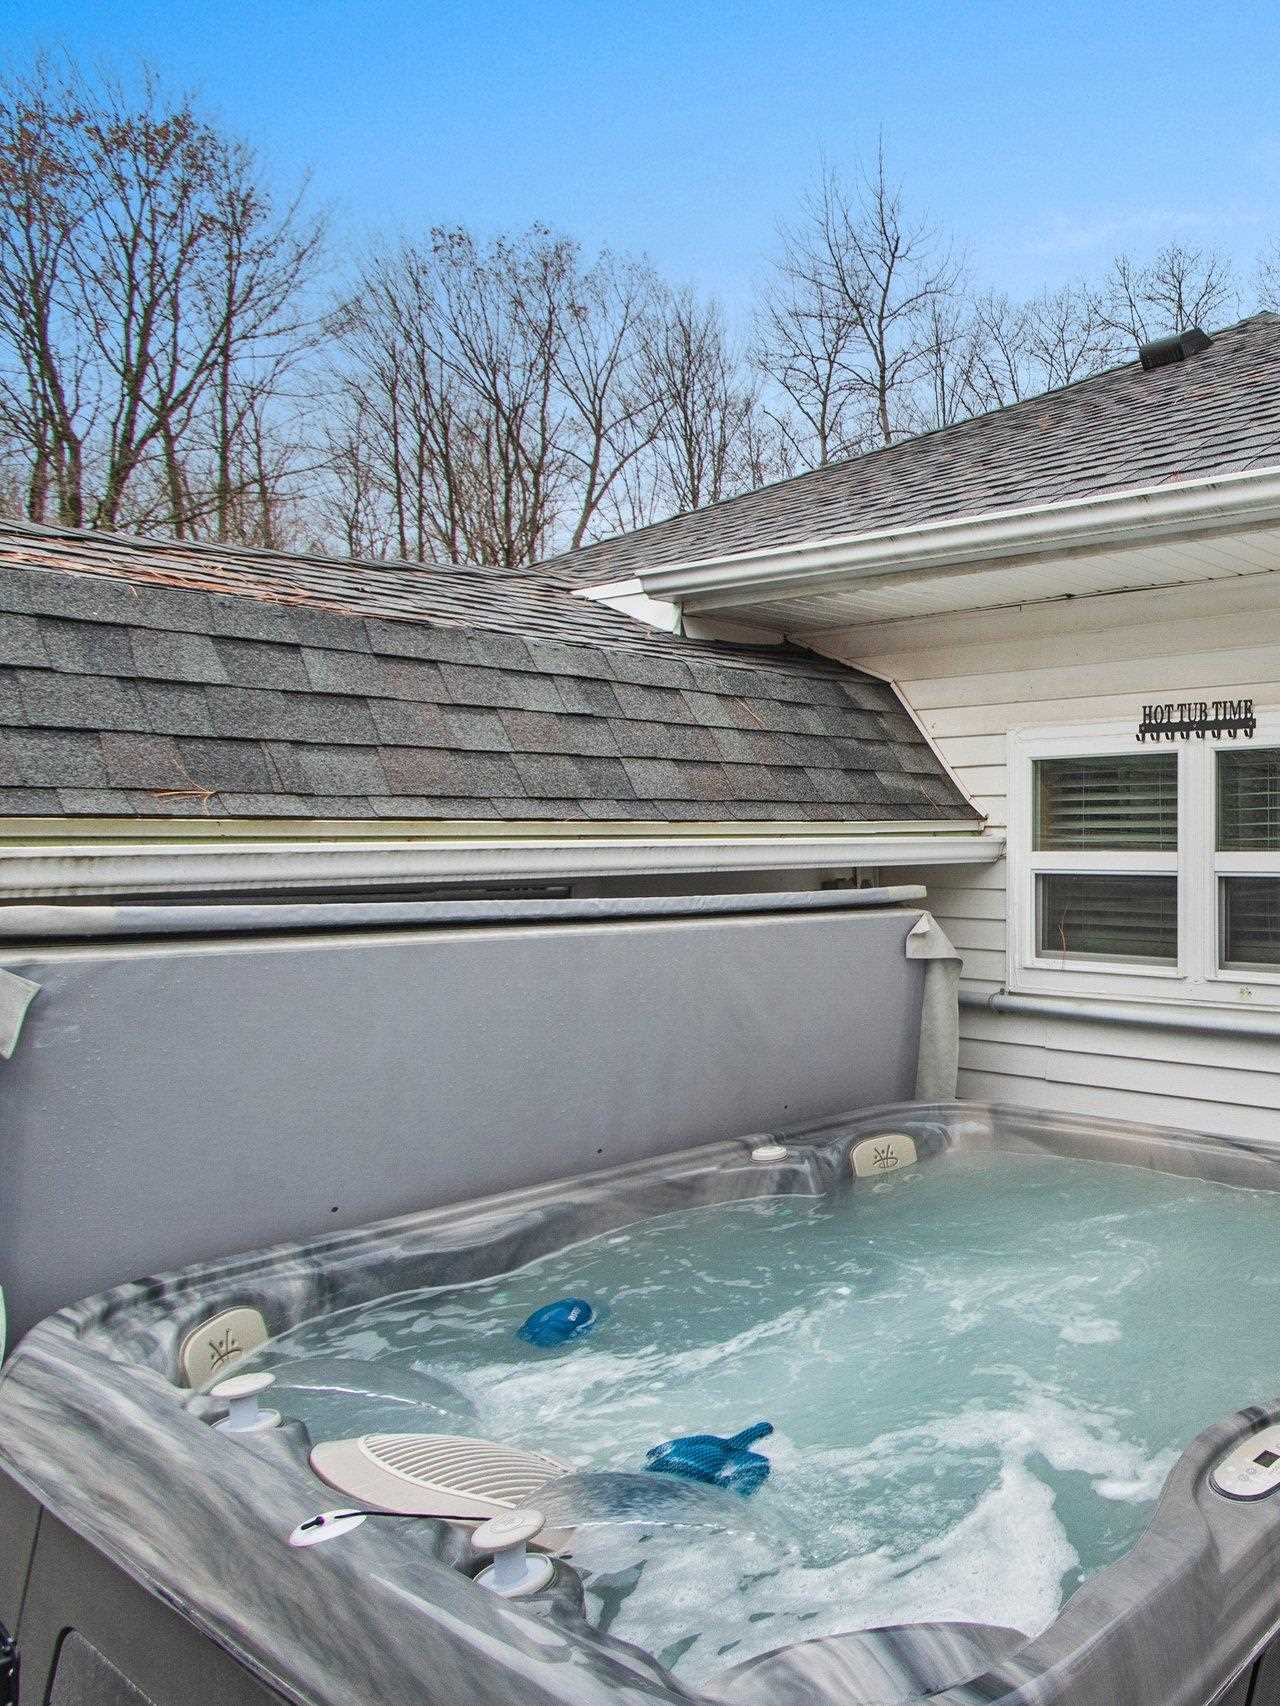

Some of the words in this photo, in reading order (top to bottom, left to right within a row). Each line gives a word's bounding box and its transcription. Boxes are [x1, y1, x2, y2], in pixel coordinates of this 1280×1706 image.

[1142, 704, 1174, 723] HOT
[1177, 702, 1207, 721] TUB
[1212, 699, 1253, 720] TIME
